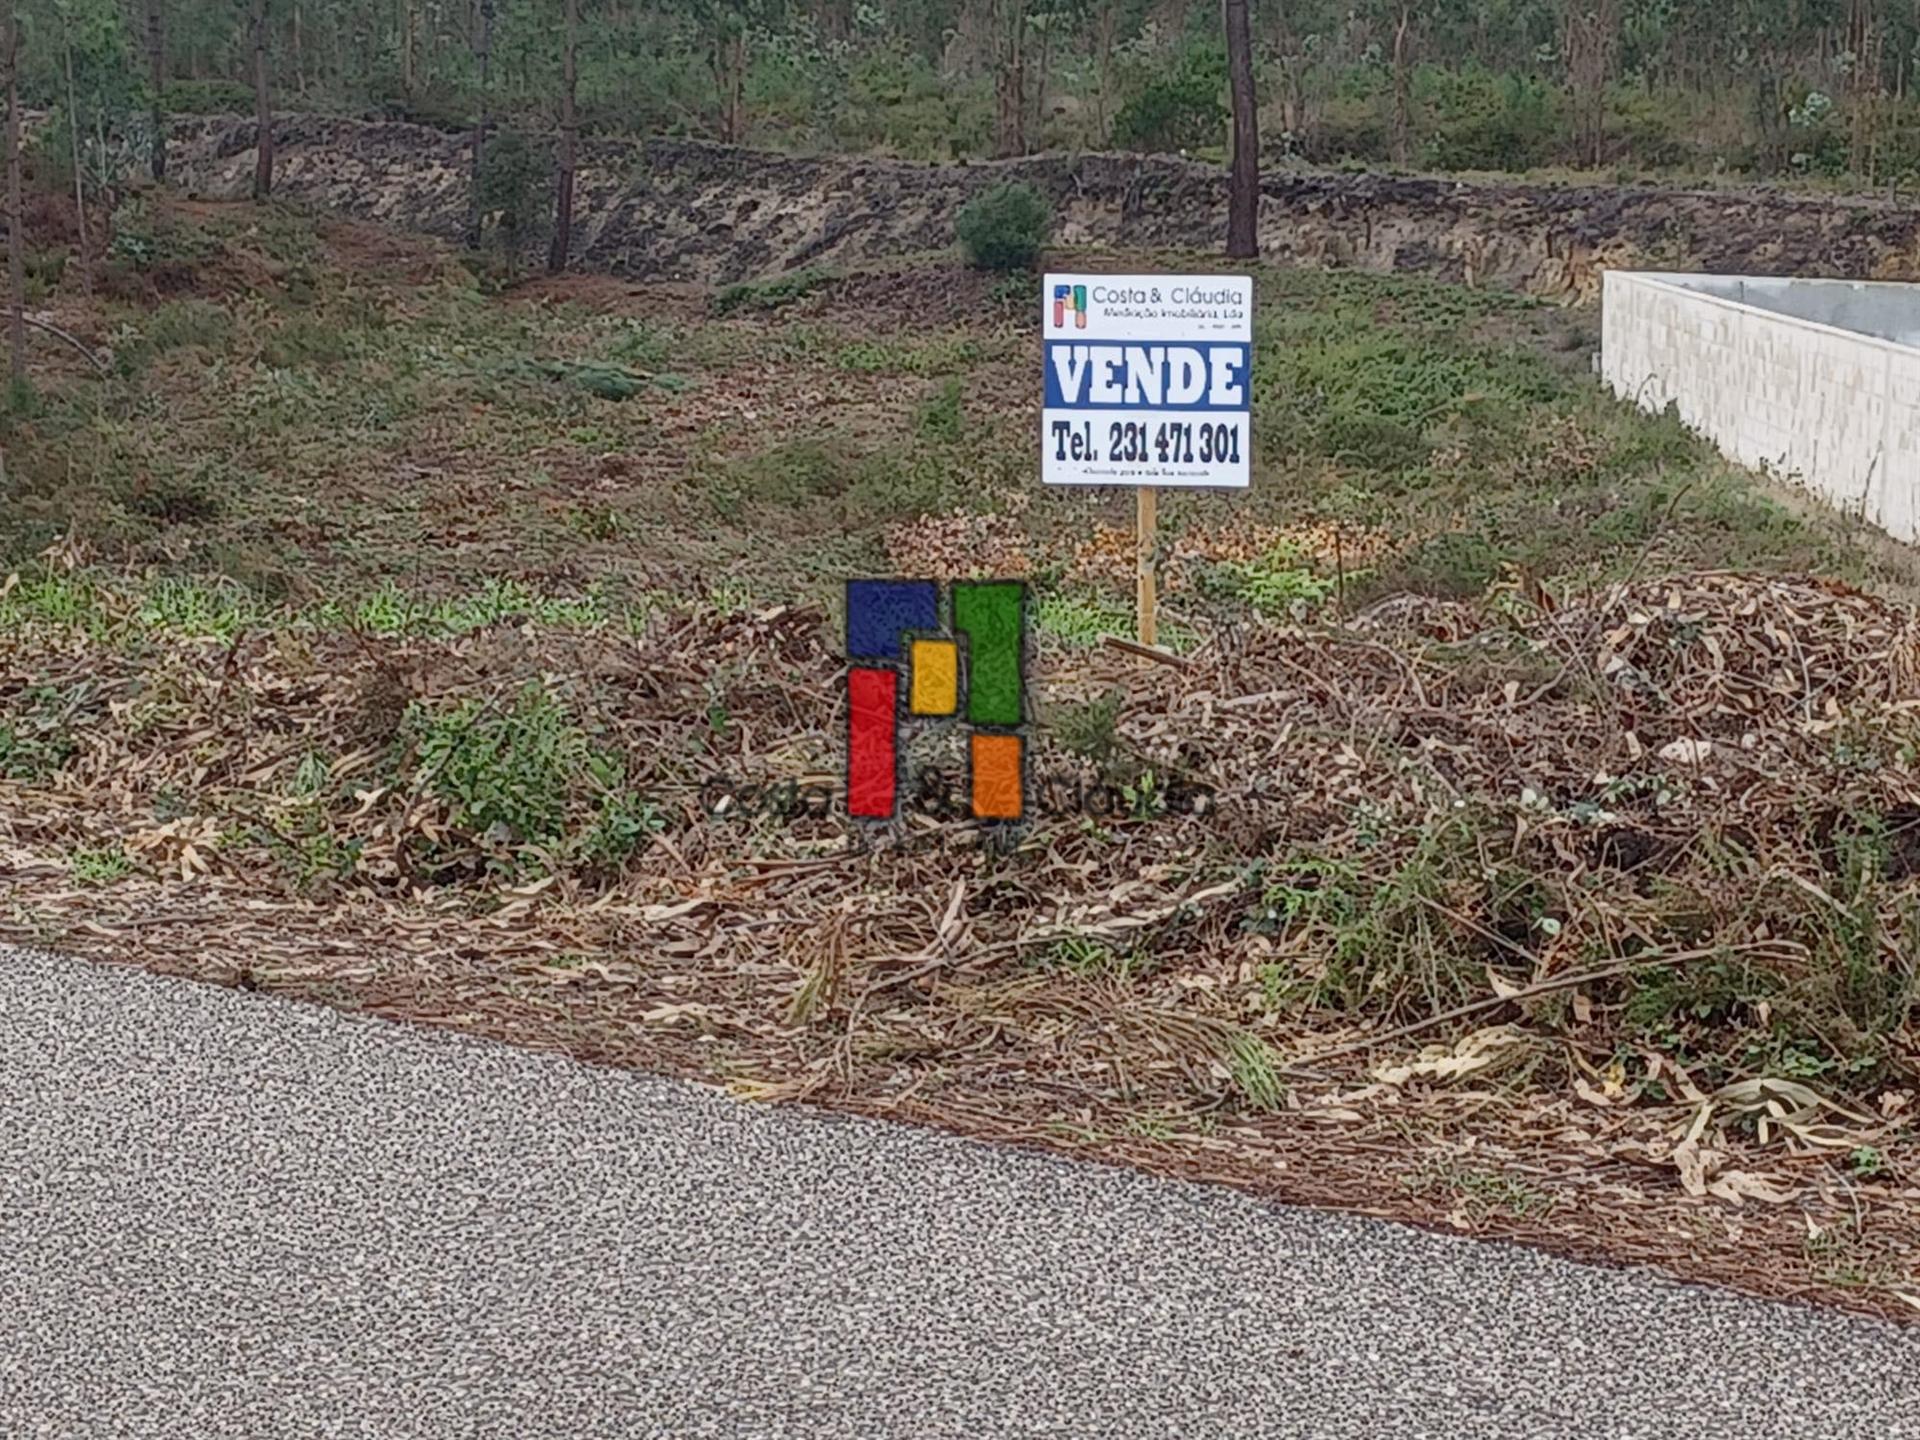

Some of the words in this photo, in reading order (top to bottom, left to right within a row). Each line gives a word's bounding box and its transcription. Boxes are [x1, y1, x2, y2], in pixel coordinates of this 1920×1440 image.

[1092, 286, 1146, 304] Costa
[1150, 287, 1162, 303] &
[1171, 286, 1242, 305] Cláudia
[1051, 345, 1243, 405] VENDE
[1052, 420, 1098, 461] Tel.
[1109, 421, 1148, 462] 231
[1155, 422, 1194, 463] 471
[1199, 423, 1240, 463] 301
